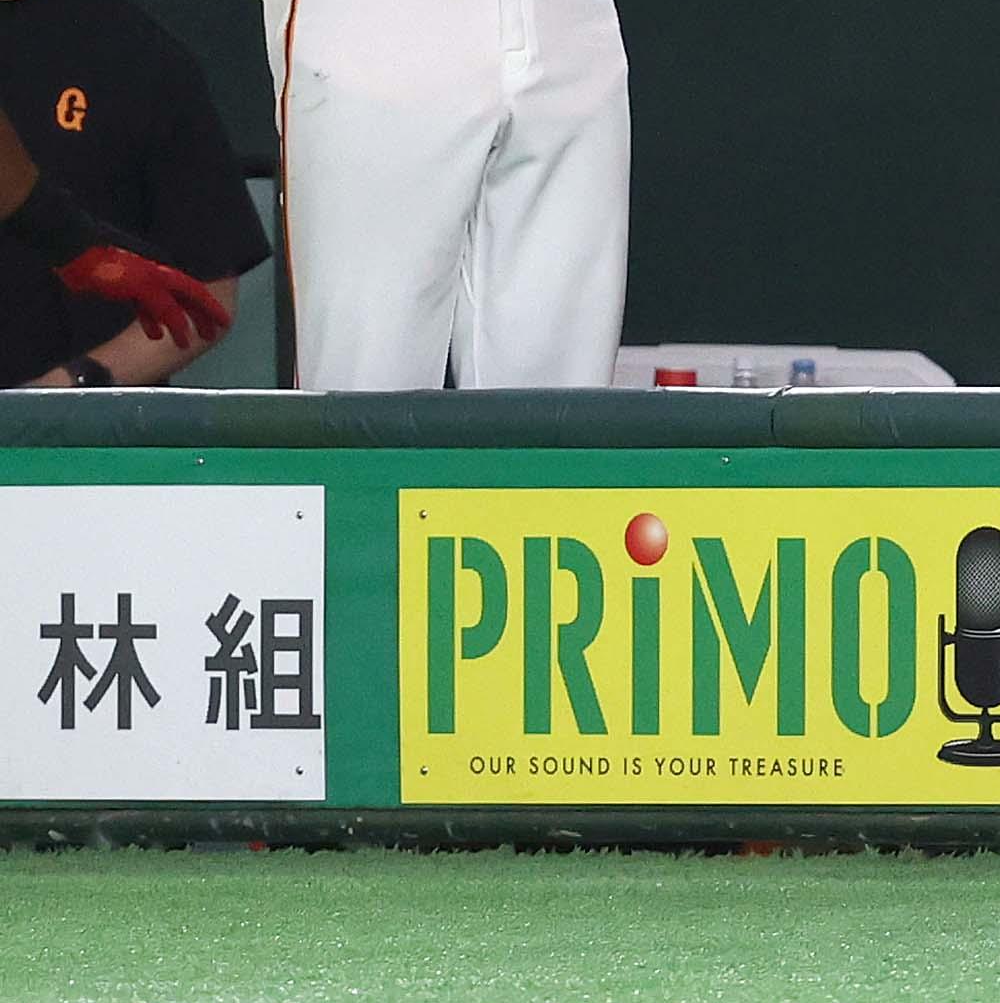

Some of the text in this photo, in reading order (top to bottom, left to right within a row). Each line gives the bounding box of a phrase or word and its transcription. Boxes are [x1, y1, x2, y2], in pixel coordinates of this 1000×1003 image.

[56, 87, 88, 132] G
[470, 756, 843, 777] OUR SOUND IS YOUR TREASURE
